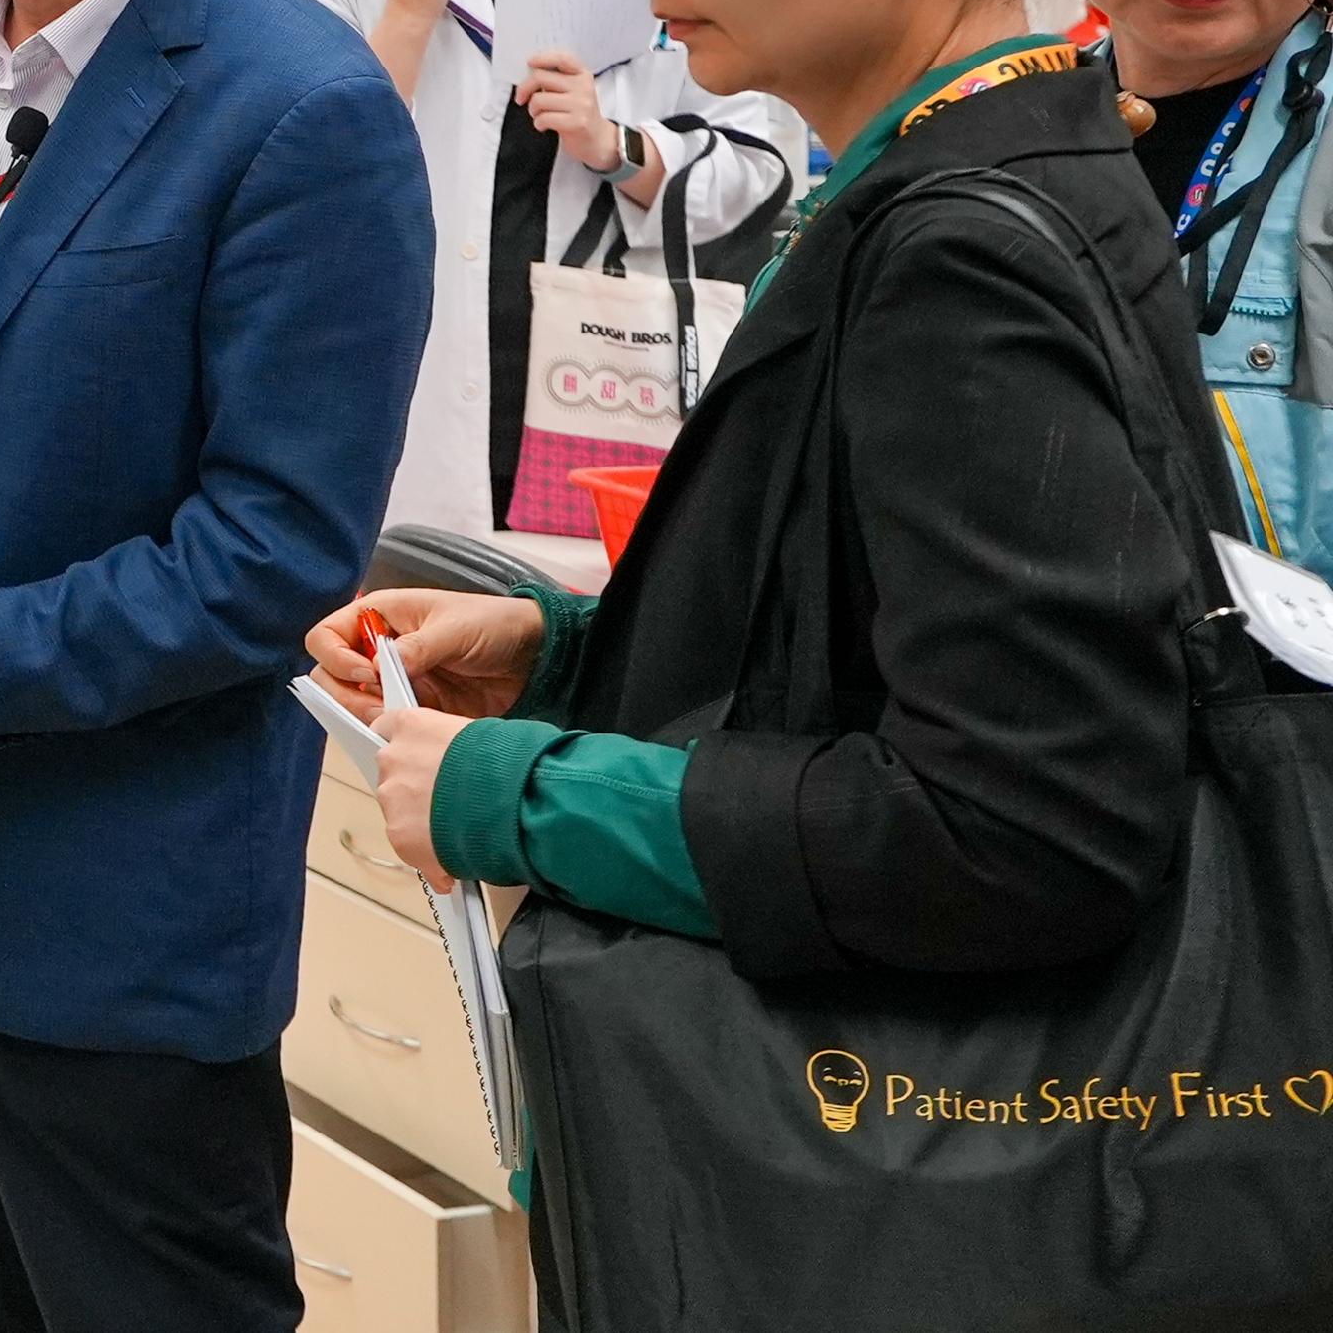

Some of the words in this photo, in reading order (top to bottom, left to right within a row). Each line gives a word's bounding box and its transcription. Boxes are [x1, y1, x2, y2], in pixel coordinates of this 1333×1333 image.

[885, 1073, 1029, 1125] Patient
[1039, 1077, 1156, 1131] Safety
[1169, 1071, 1272, 1118] First
